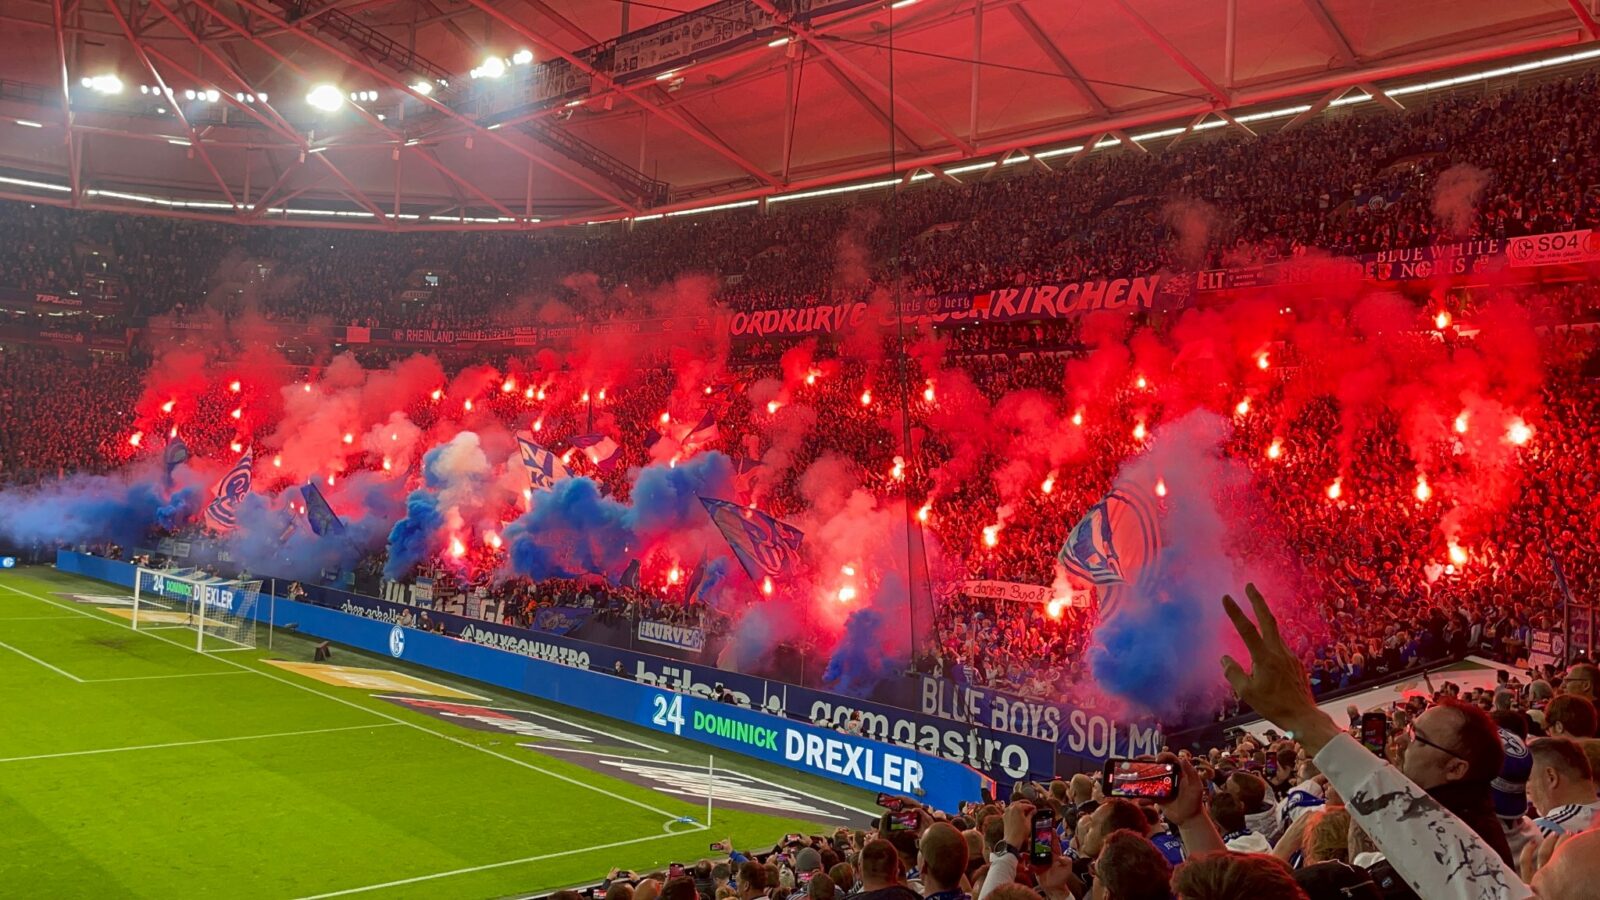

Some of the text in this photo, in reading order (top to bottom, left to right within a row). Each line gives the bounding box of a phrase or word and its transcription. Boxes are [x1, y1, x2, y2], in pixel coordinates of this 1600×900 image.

[1376, 239, 1499, 263] BLUE WHITE
[406, 328, 454, 344] RHEINLAND
[153, 574, 165, 596] 24
[193, 583, 234, 610] DEXLER
[645, 621, 692, 646] KURVE
[922, 677, 985, 727] BLUE
[991, 695, 1060, 743] BOYS
[653, 693, 925, 794] 24 DOMINICK DREXLER
